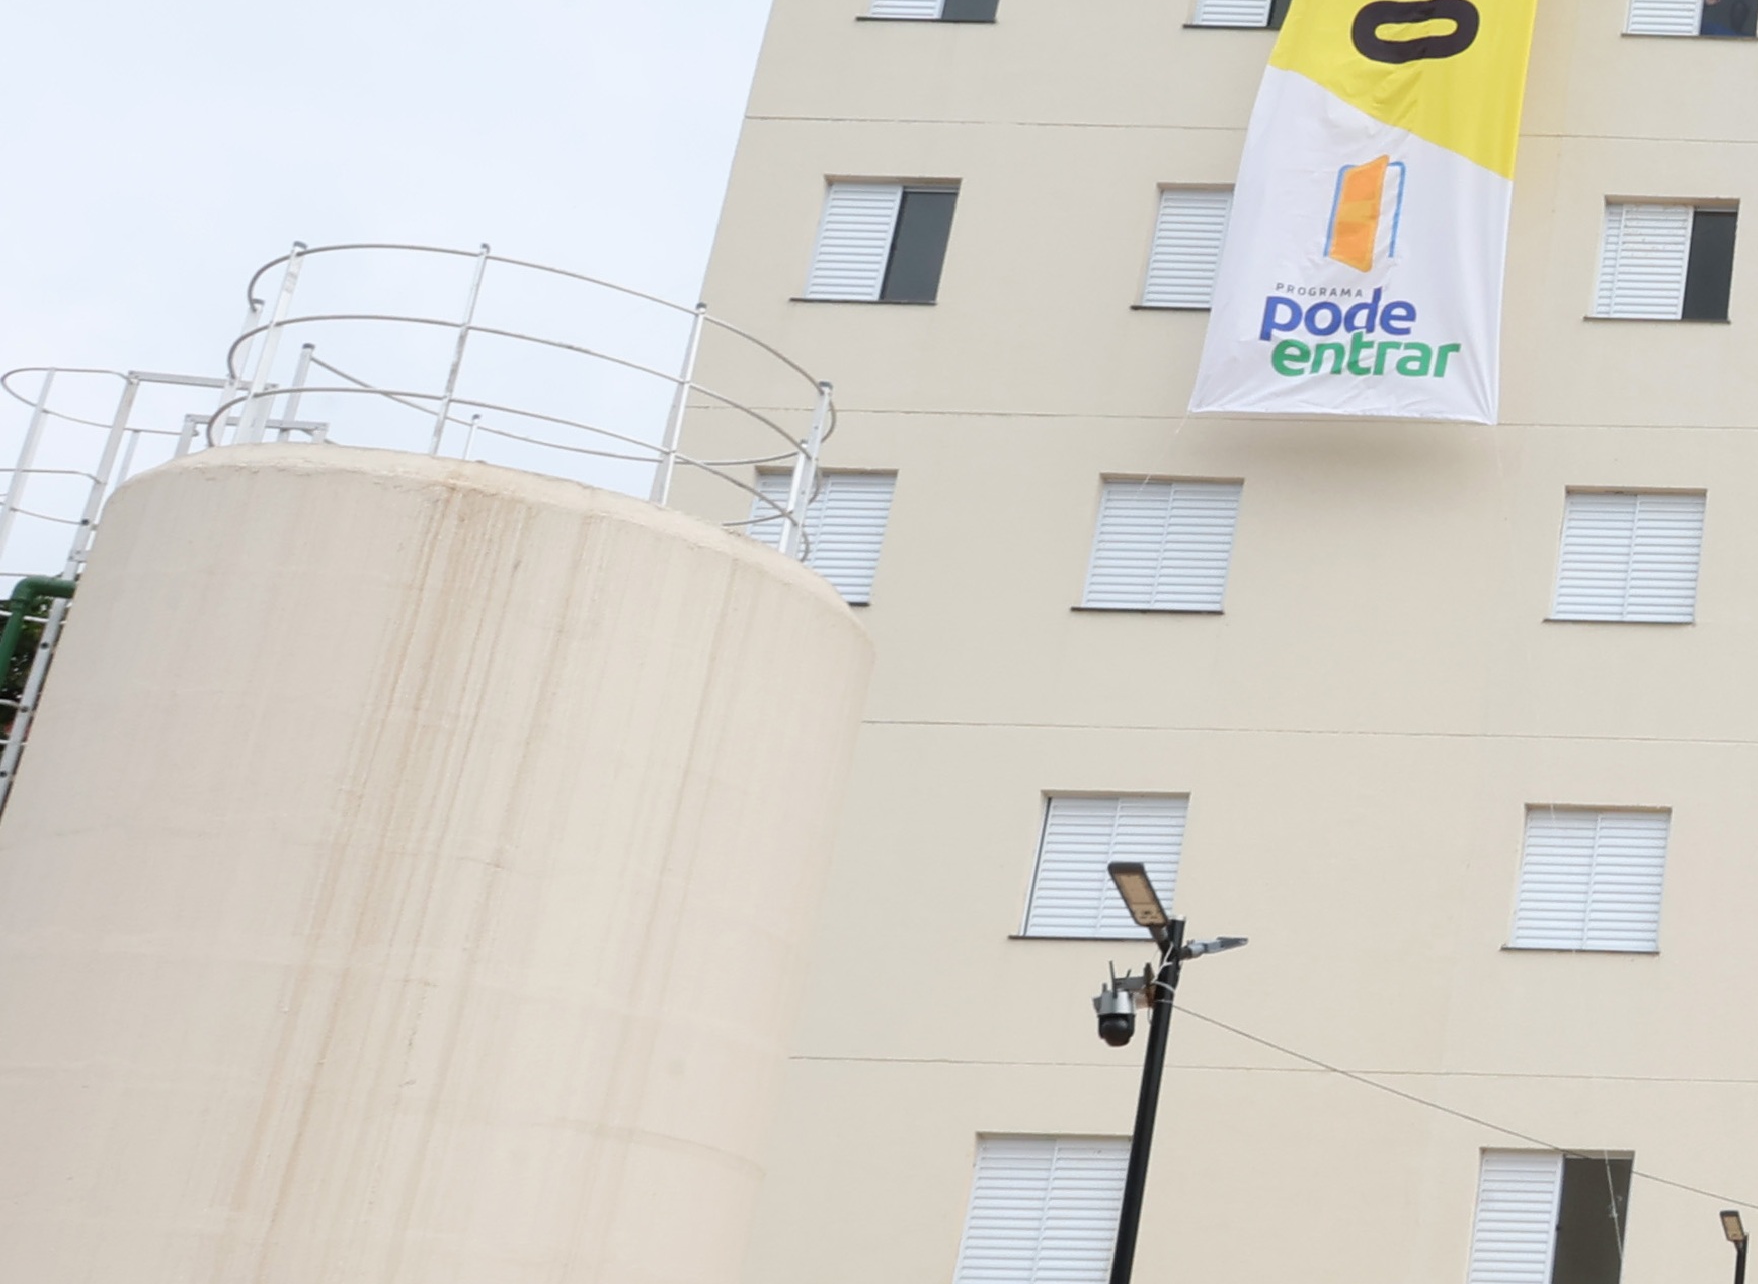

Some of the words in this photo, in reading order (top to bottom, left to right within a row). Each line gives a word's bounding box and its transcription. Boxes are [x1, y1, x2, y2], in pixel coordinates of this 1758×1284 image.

[1276, 282, 1364, 298] PROGRAMA
[1259, 287, 1417, 342] pode
[1271, 331, 1462, 378] entrar
